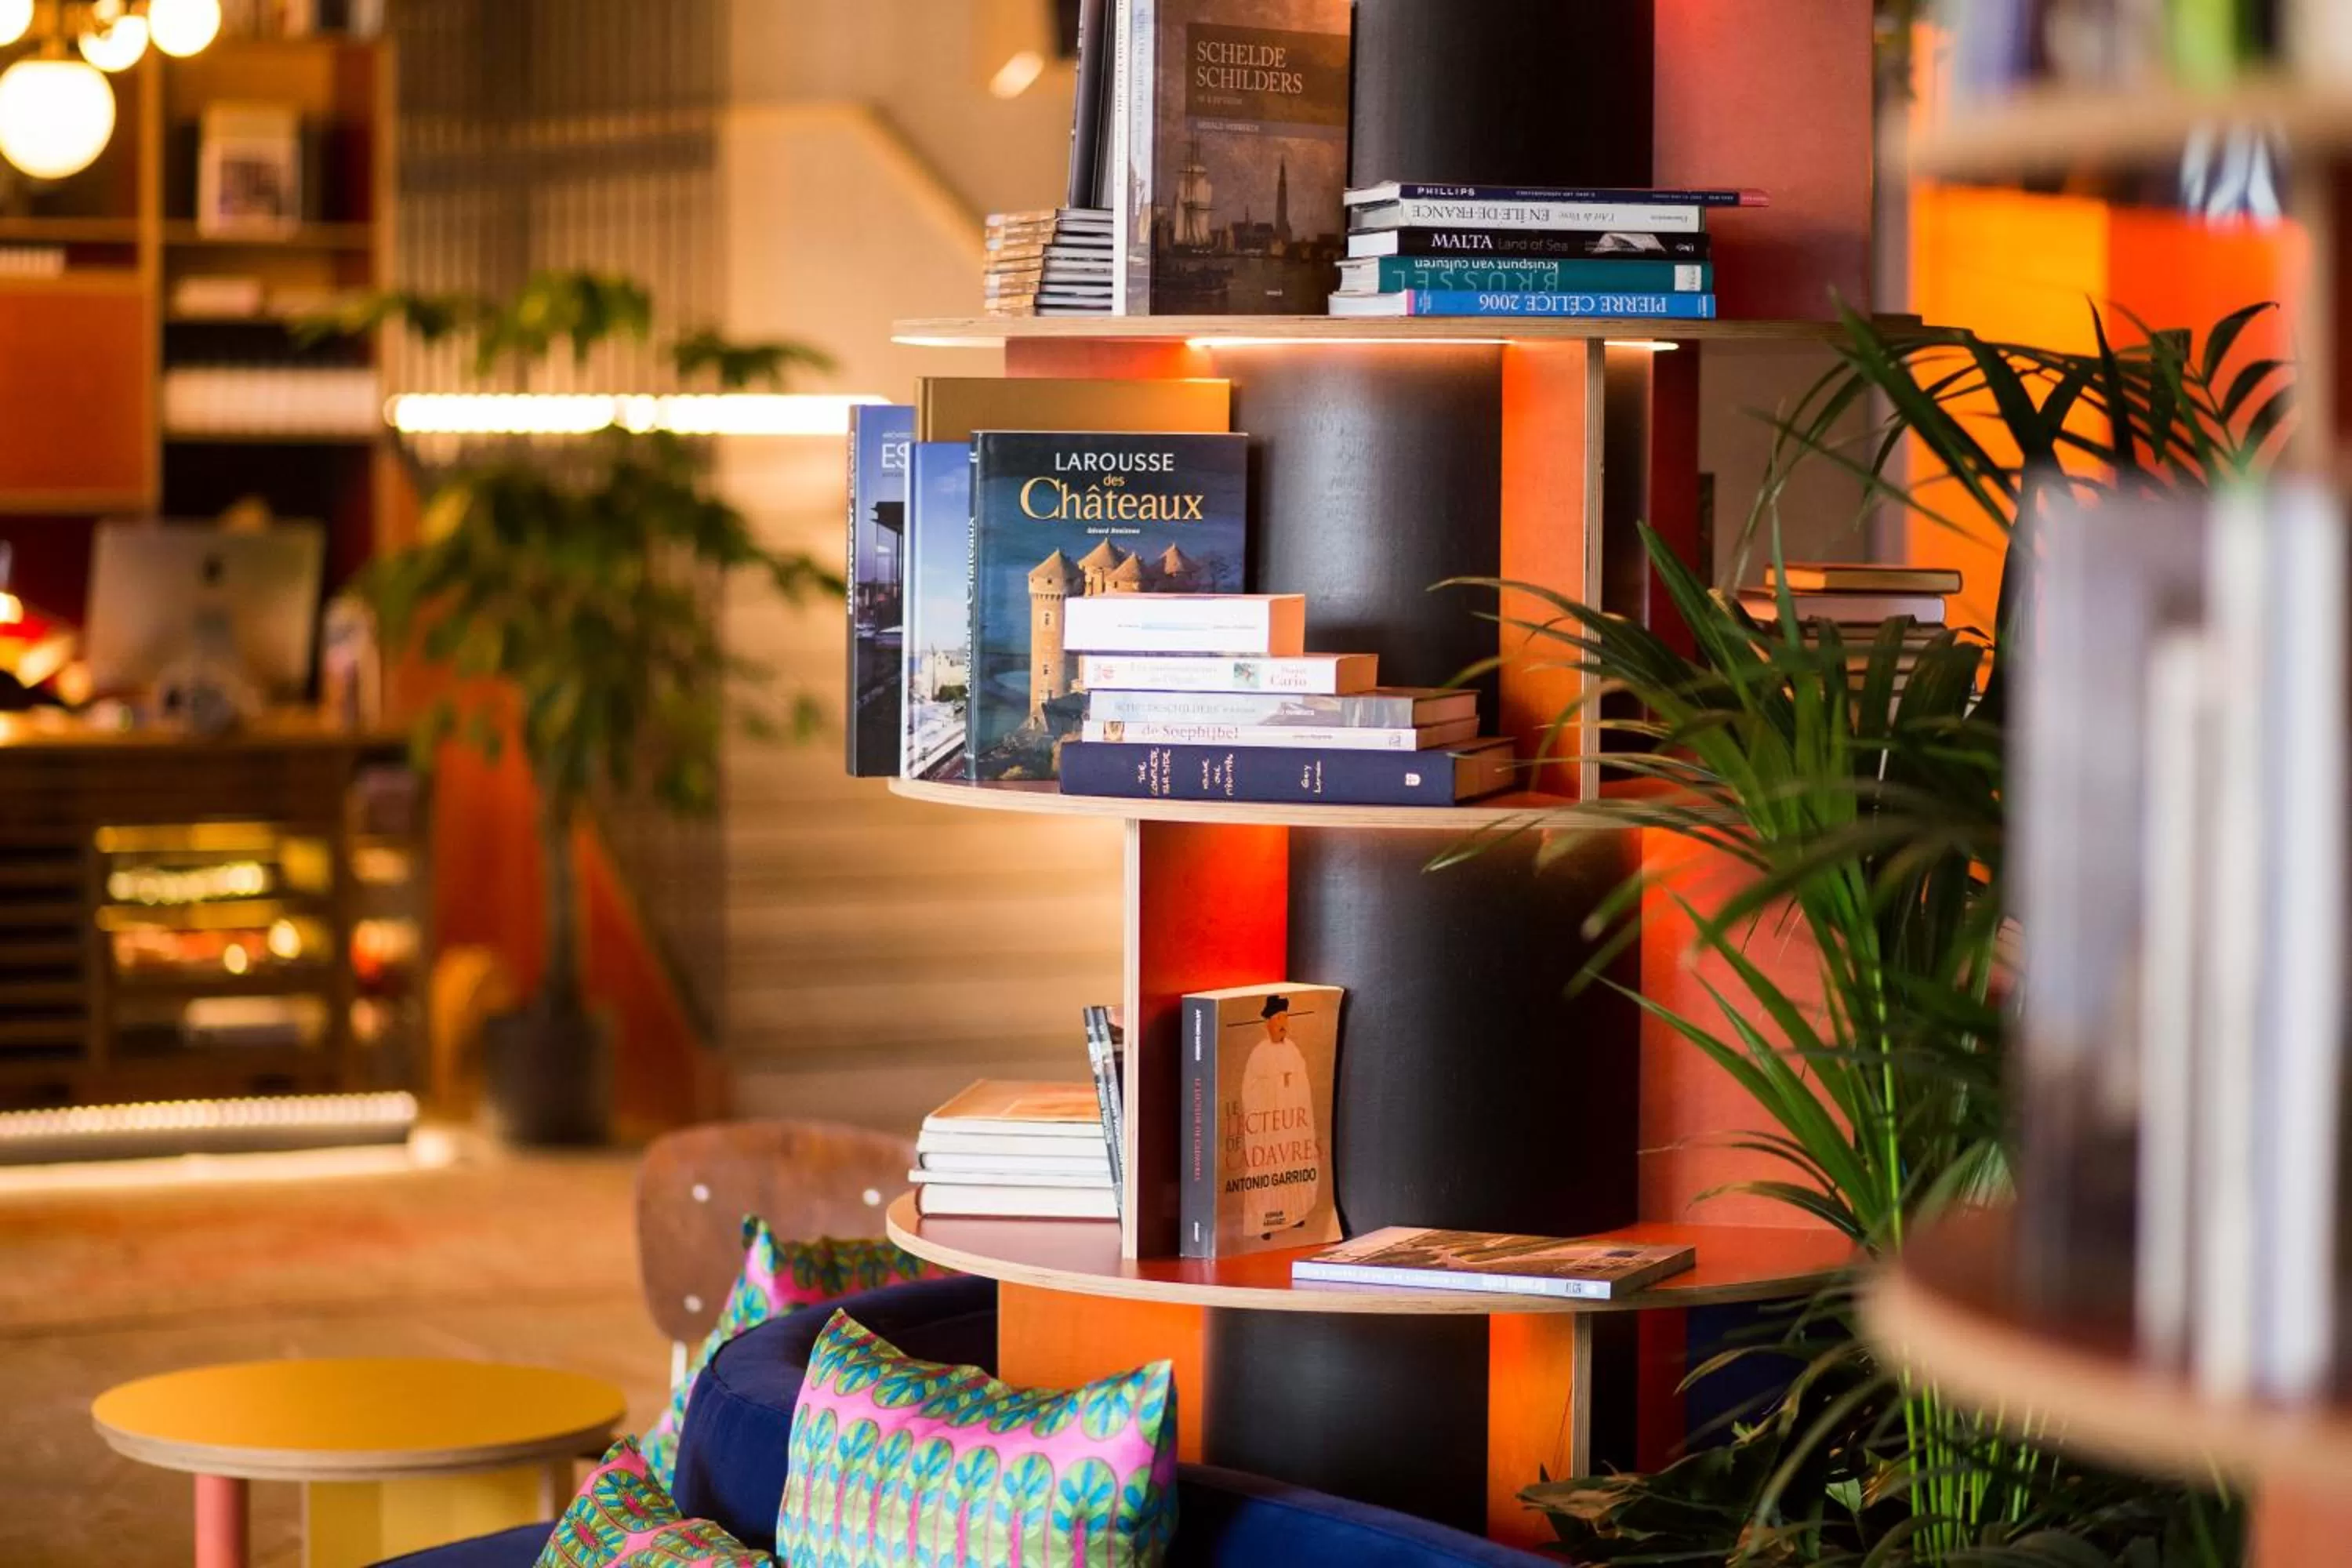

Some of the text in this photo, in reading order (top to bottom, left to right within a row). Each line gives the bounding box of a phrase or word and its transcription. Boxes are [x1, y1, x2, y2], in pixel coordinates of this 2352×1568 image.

[1197, 41, 1286, 68] SCHELDE
[1196, 66, 1302, 94] SCHILDERS
[1417, 187, 1475, 196] PHILLIPS
[1530, 207, 1550, 222] EN
[1432, 234, 1569, 252] MALTA Land of Sea
[1414, 258, 1559, 274] kruispunt van culturen
[1392, 270, 1559, 292] BRUSSEL
[1479, 294, 1519, 310] 2006
[1600, 295, 1668, 313] PIERRE
[1054, 452, 1174, 472] LAROUSSE
[1103, 474, 1125, 487] des
[1020, 476, 1204, 521] Châteaux
[1301, 764, 1312, 789] Gary
[1226, 1101, 1240, 1116] LE
[1227, 1106, 1308, 1136] LECTEUR
[1226, 1137, 1242, 1152] DE
[1225, 1138, 1325, 1171] CADAVRES
[1225, 1167, 1316, 1194] ANTONIO GARRIDO
